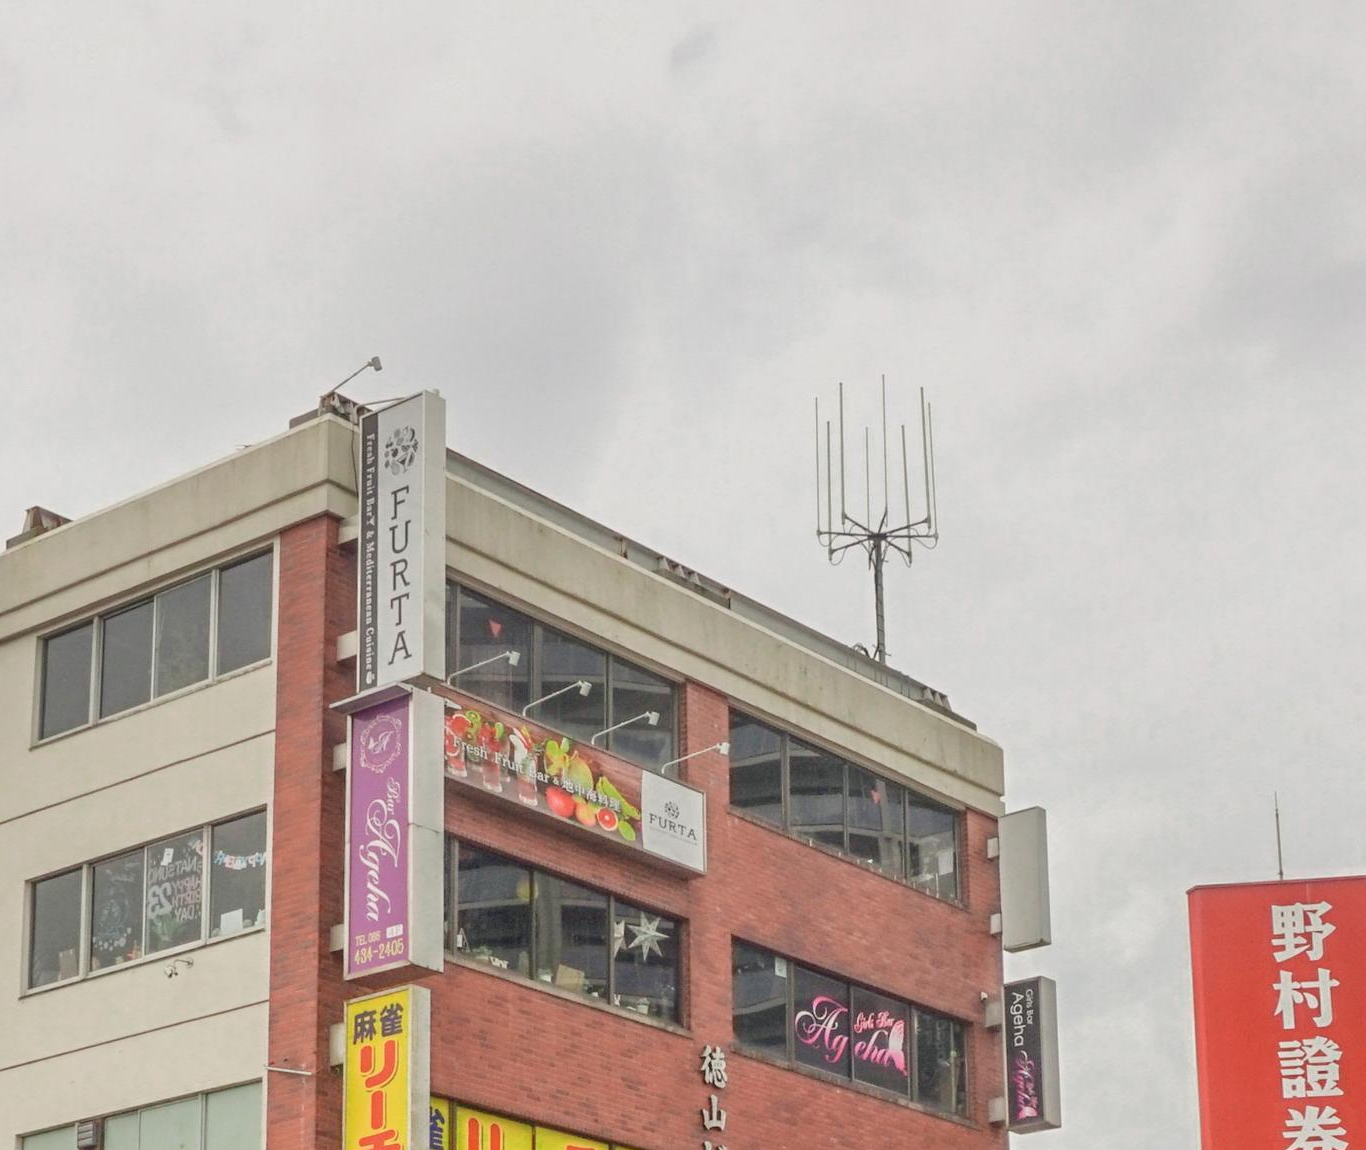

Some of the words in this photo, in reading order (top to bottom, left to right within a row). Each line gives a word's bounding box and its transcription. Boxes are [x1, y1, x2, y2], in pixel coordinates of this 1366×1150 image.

[387, 485, 412, 666] FURTA
[453, 738, 488, 759] Fresh
[494, 752, 523, 771] Fruit
[528, 768, 550, 783] Bar
[649, 813, 697, 841] FURTA
[359, 799, 402, 921] Ageha
[355, 938, 404, 965] 434-2405
[353, 1003, 404, 1044] 麻雀
[1010, 992, 1026, 1047] Ageha
